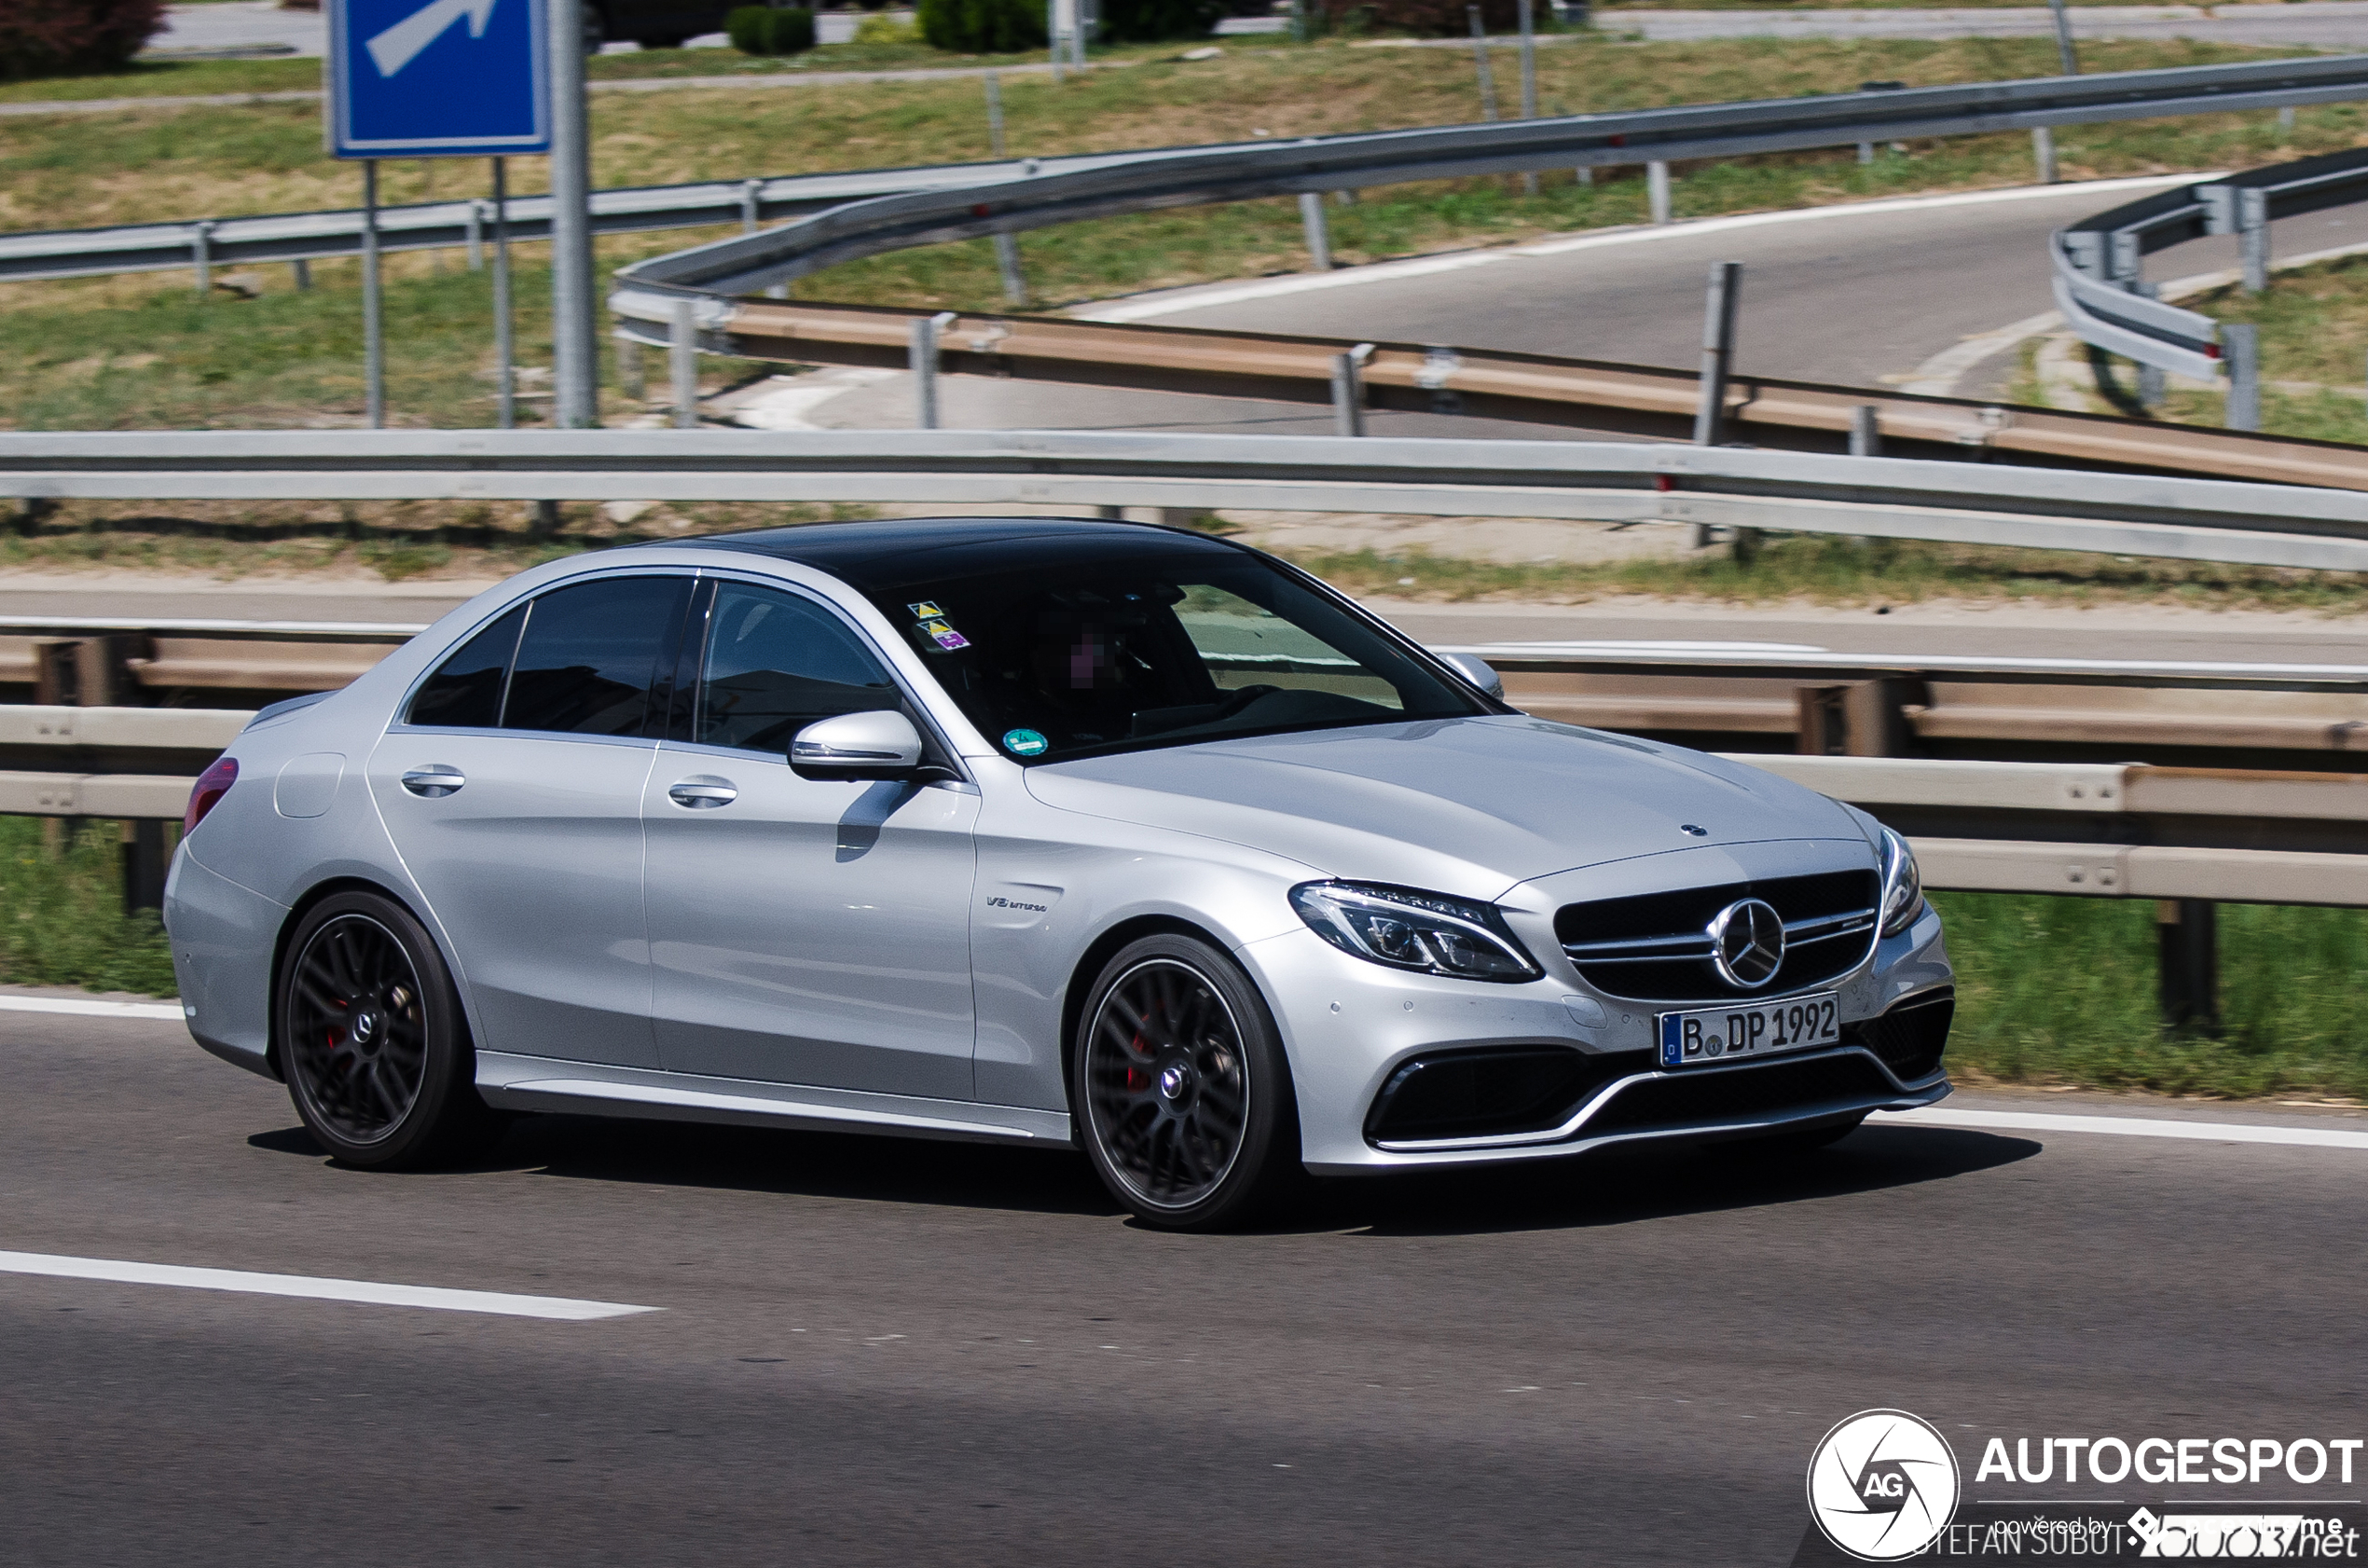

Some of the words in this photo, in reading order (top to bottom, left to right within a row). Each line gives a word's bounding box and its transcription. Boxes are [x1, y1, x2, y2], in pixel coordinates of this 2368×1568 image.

[986, 896, 1009, 907] V8
[1682, 1018, 1703, 1056] B
[1727, 1011, 1765, 1052] DP
[1771, 999, 1836, 1047] 1992
